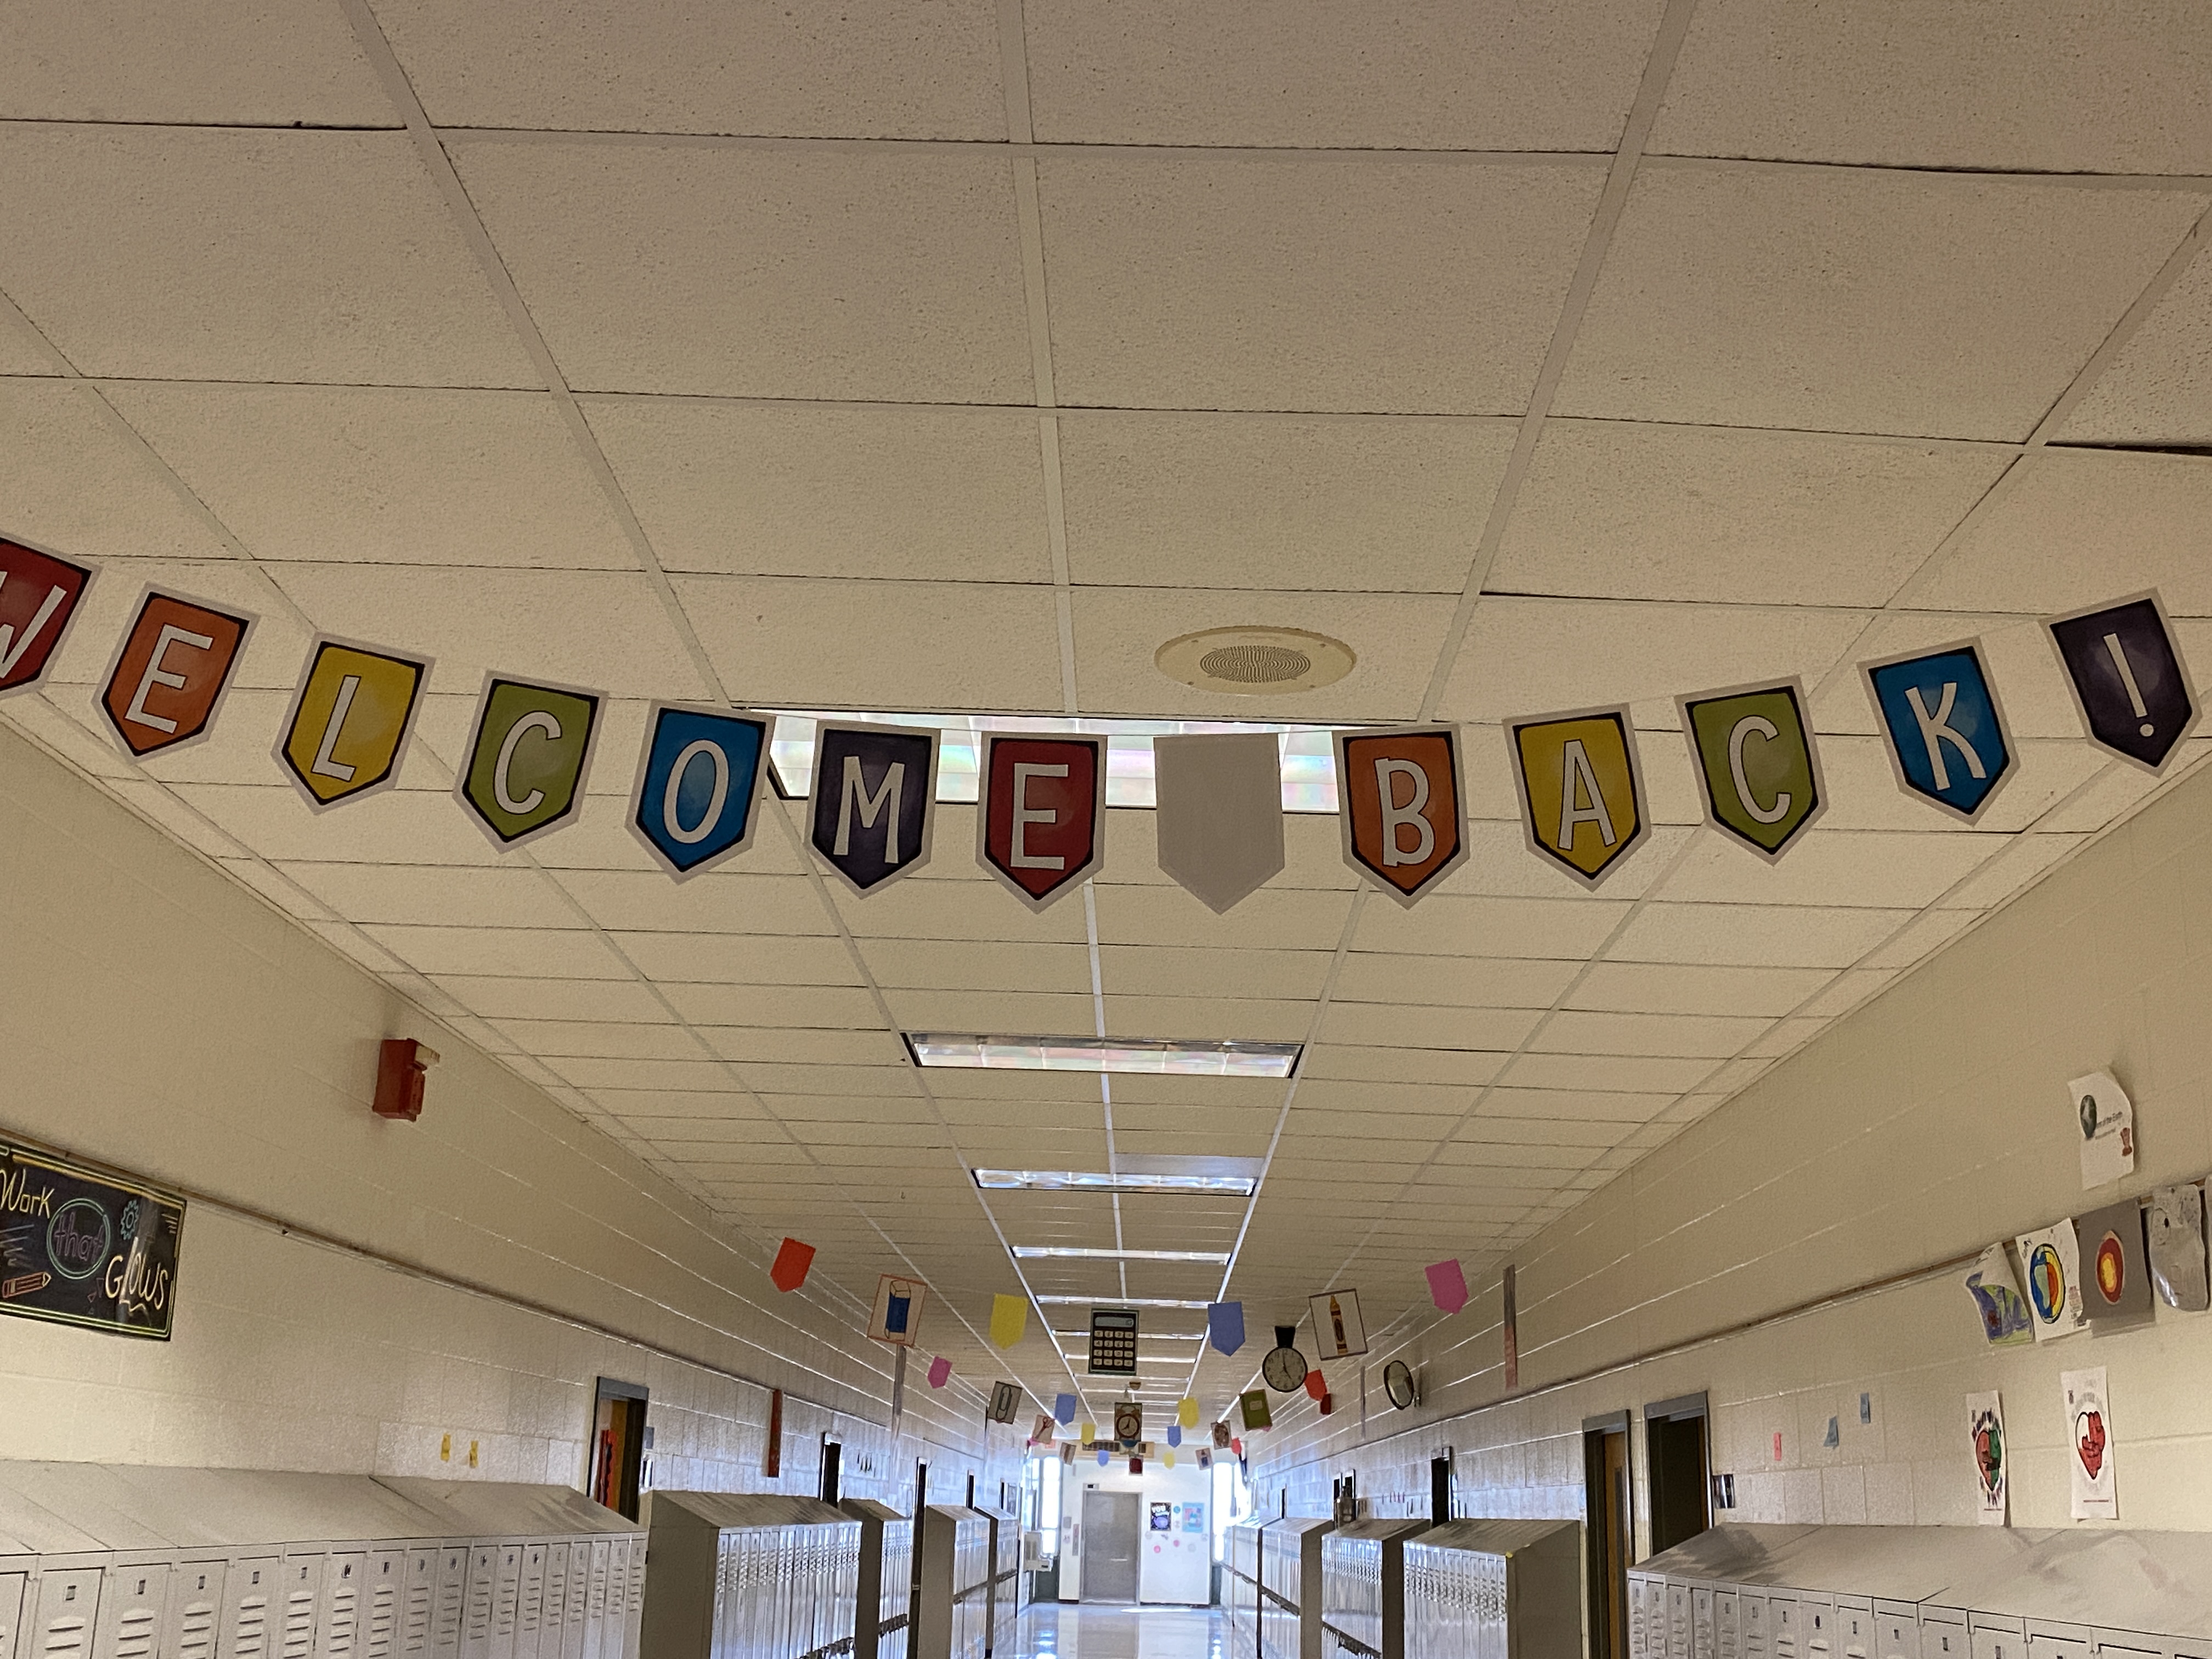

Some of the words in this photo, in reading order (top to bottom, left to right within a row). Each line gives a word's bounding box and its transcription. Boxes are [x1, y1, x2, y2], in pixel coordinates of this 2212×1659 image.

[1373, 633, 2154, 867] BACK!
[0, 1168, 55, 1219] Work
[54, 1211, 104, 1262] that
[105, 1236, 168, 1311] Glows
